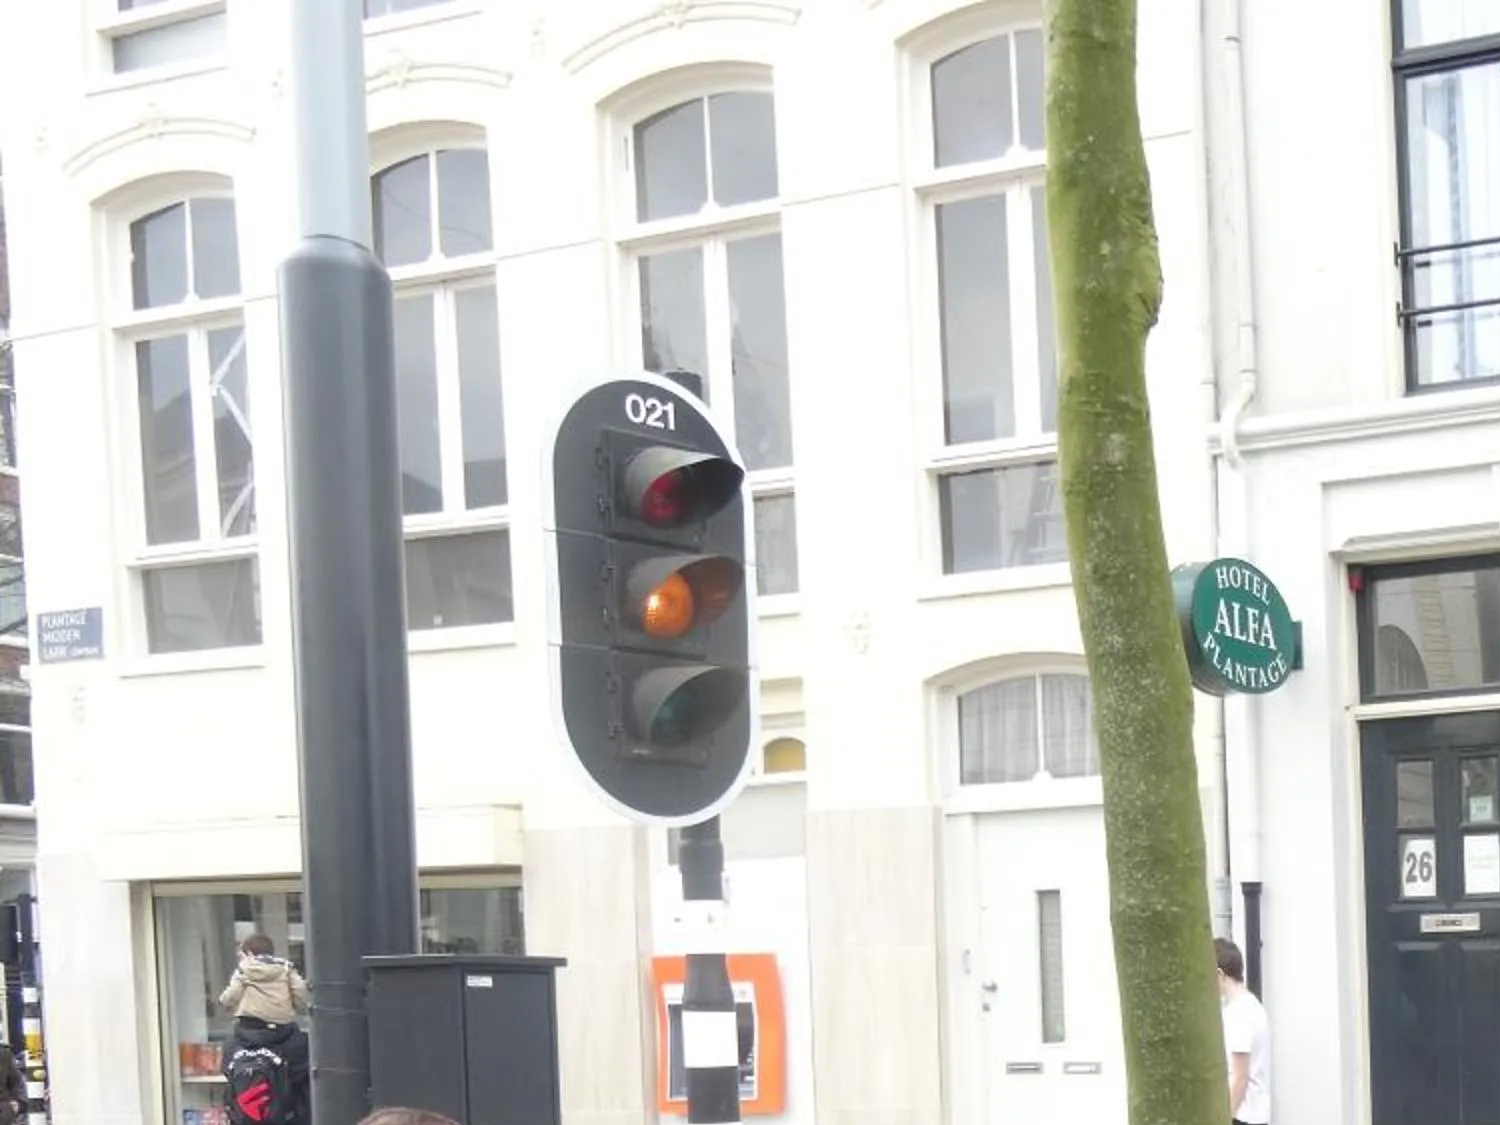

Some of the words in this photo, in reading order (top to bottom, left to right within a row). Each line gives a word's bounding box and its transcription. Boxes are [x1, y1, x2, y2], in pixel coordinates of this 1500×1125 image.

[625, 393, 676, 431] 021
[1215, 565, 1271, 606] HOTEL
[1214, 597, 1277, 650] ALFA
[1203, 632, 1288, 688] PLANTAGE
[1405, 851, 1433, 883] 26
